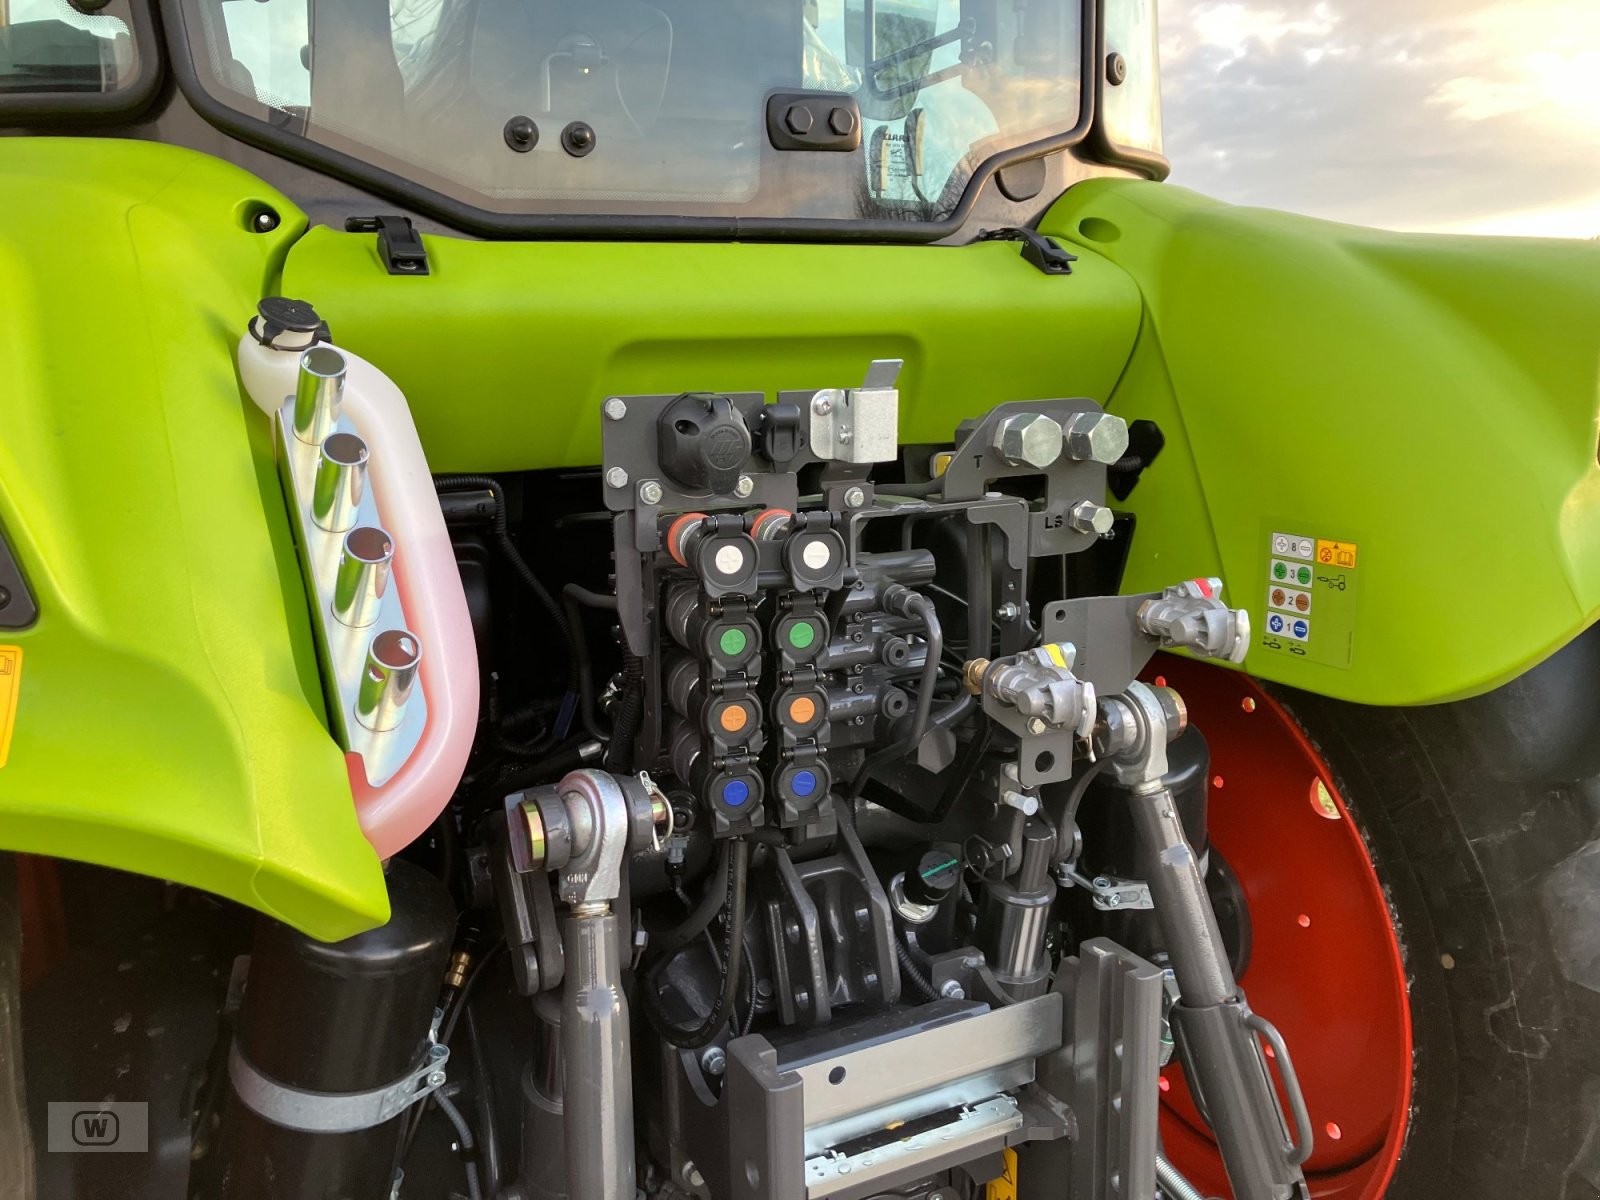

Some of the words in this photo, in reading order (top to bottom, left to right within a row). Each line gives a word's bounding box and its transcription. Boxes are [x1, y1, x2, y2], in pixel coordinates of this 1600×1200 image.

[973, 454, 983, 469] T
[1045, 515, 1064, 529] LS
[1291, 542, 1297, 552] 8
[1290, 569, 1295, 579] 3
[1288, 596, 1294, 606] 2
